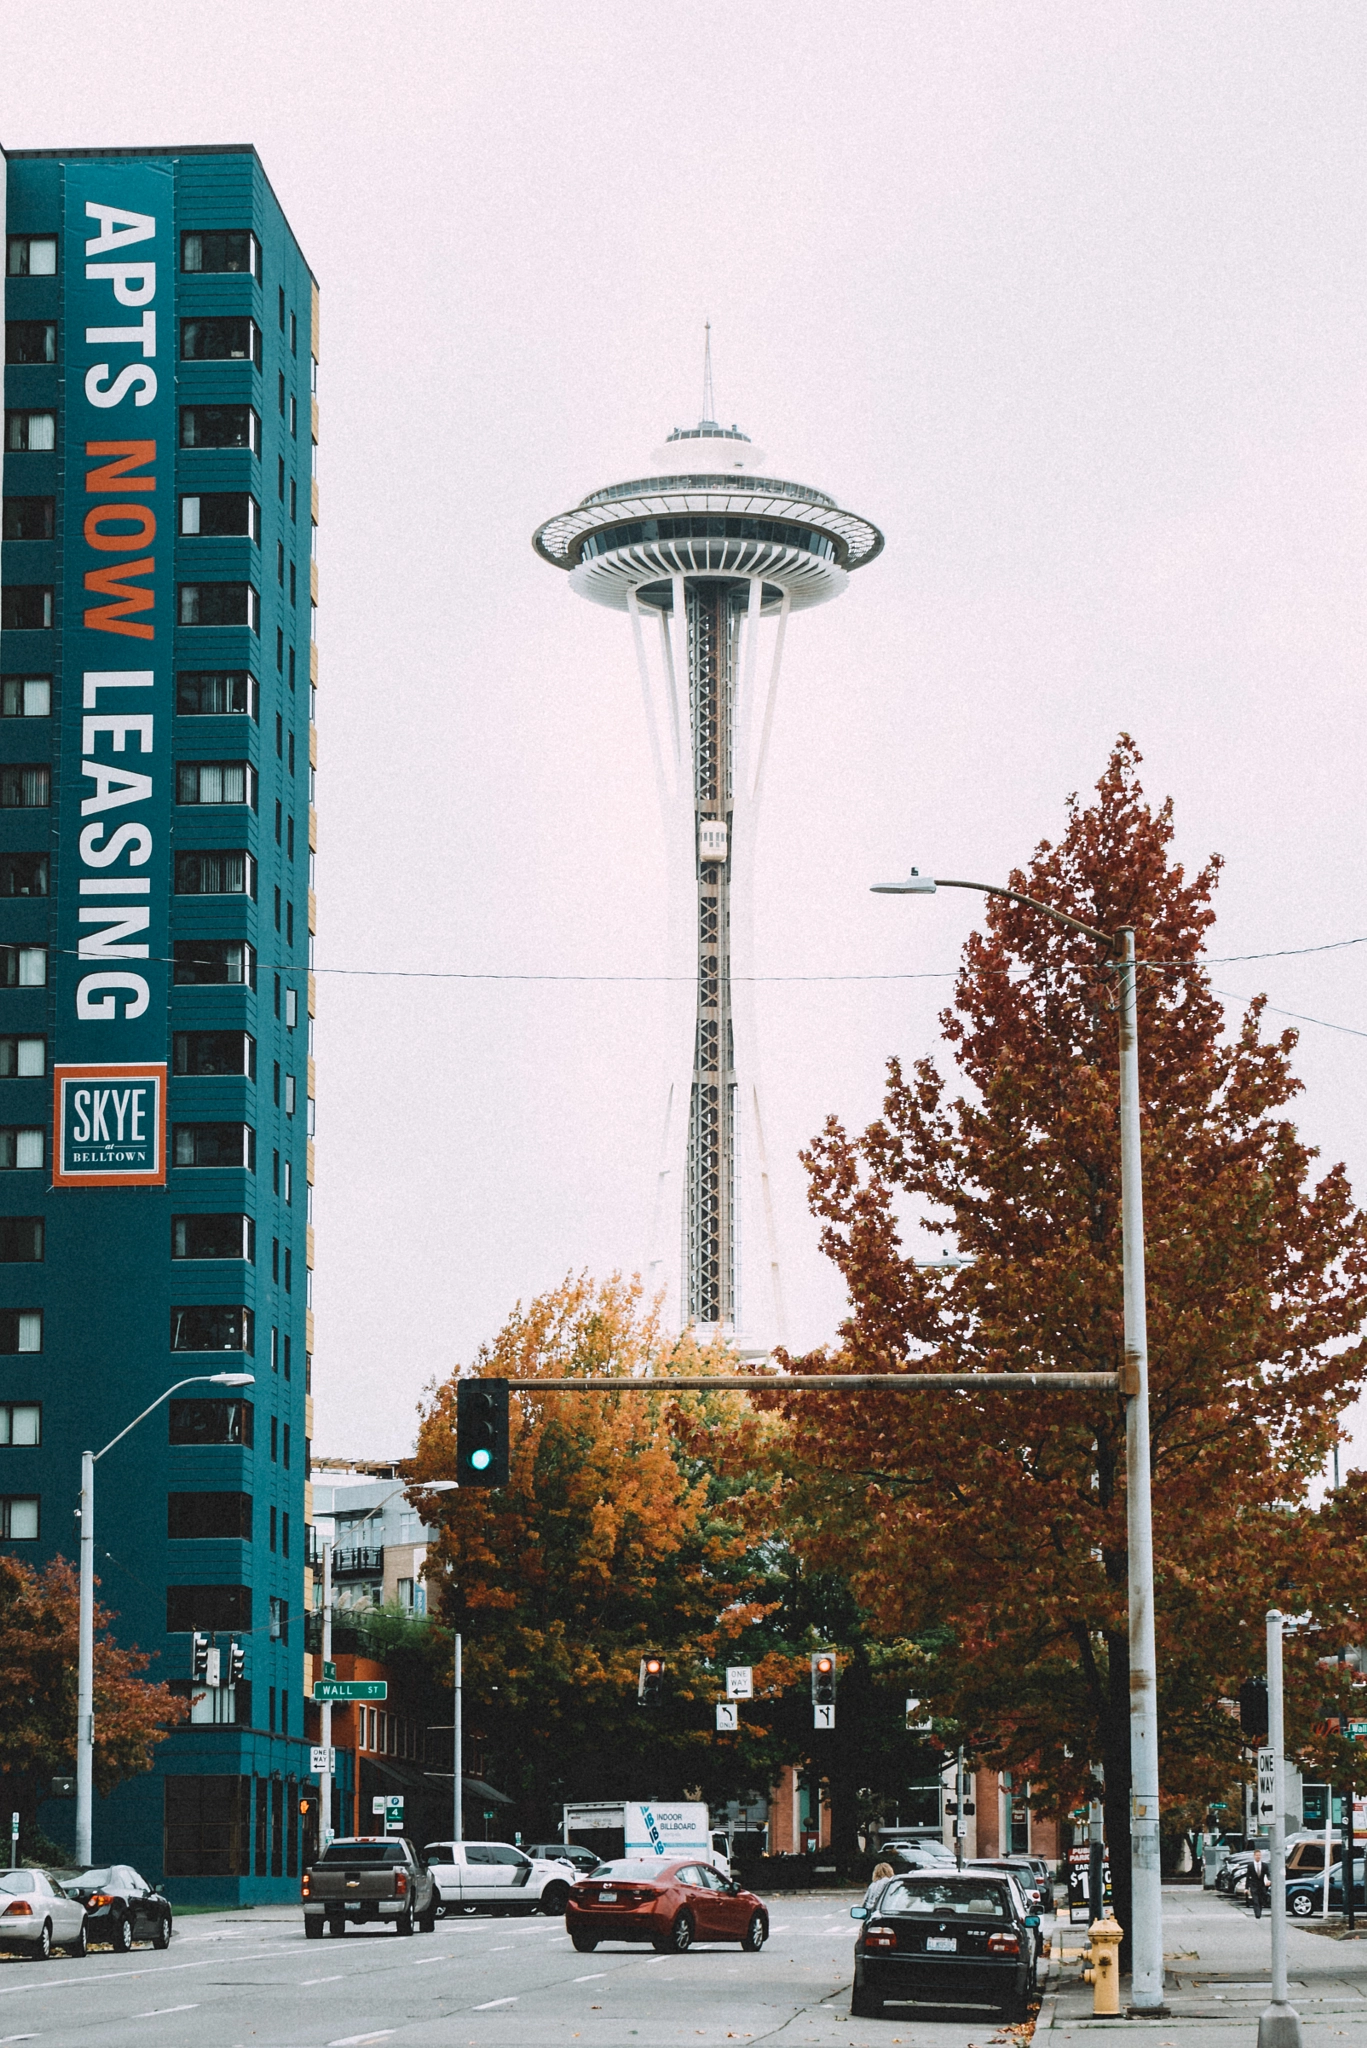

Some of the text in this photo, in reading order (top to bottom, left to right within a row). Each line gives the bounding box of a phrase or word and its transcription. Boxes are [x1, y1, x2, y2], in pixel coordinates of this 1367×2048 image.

[76, 201, 158, 1020] APTS NOW LEASING
[73, 1089, 146, 1142] SKYE
[73, 1152, 146, 1162] BELLTOWN
[731, 1670, 747, 1678] ONE
[322, 1685, 379, 1695] WALL ST
[1260, 1754, 1273, 1772] ONE
[1260, 1777, 1274, 1793] WAY
[391, 1808, 399, 1816] 4
